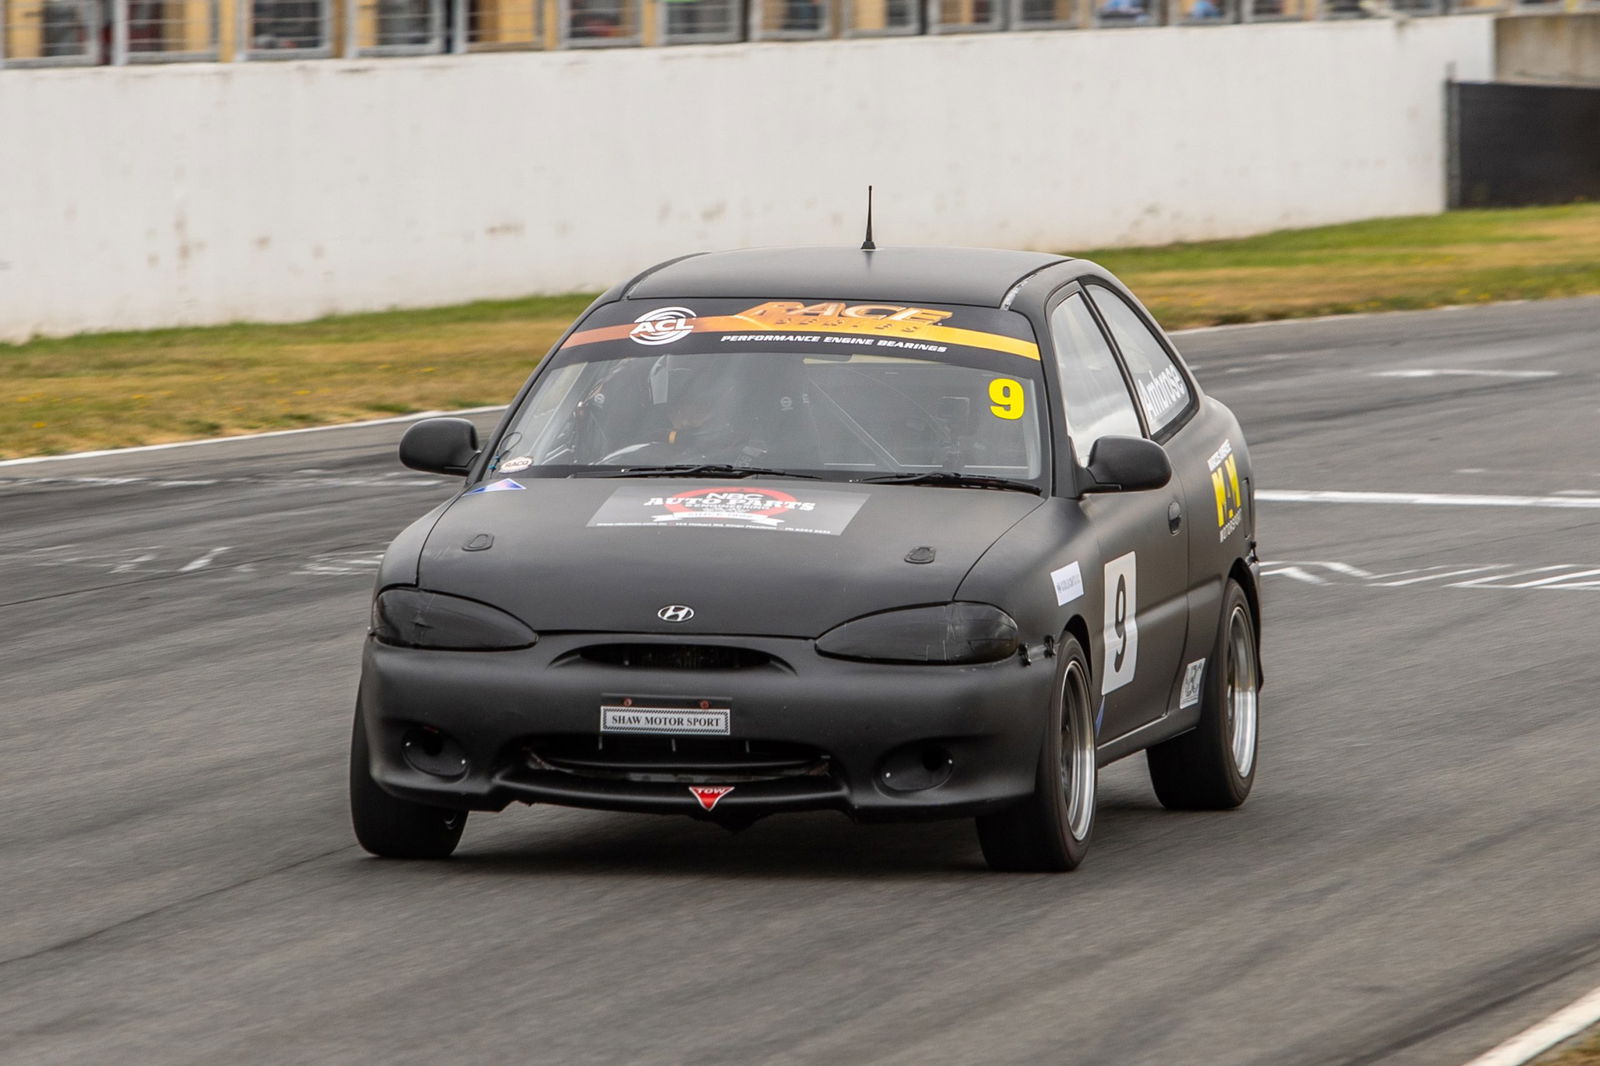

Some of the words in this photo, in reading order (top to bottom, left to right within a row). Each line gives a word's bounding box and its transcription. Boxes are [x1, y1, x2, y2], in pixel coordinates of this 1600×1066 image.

[735, 301, 953, 323] RACE
[629, 318, 694, 335] ACL
[720, 334, 820, 343] PERFORMANCE
[823, 336, 875, 346] ENGINE
[876, 339, 948, 353] BEARINGS
[988, 378, 1025, 420] 9
[1138, 364, 1185, 421] Ambrose
[643, 497, 721, 506] AUTO
[726, 498, 816, 511] PARTS
[705, 492, 764, 500] NBC
[1113, 573, 1127, 673] 9
[611, 714, 642, 725] SHAW
[644, 716, 685, 726] MOTOR
[686, 717, 721, 727] SPORT
[696, 787, 726, 795] TOW
